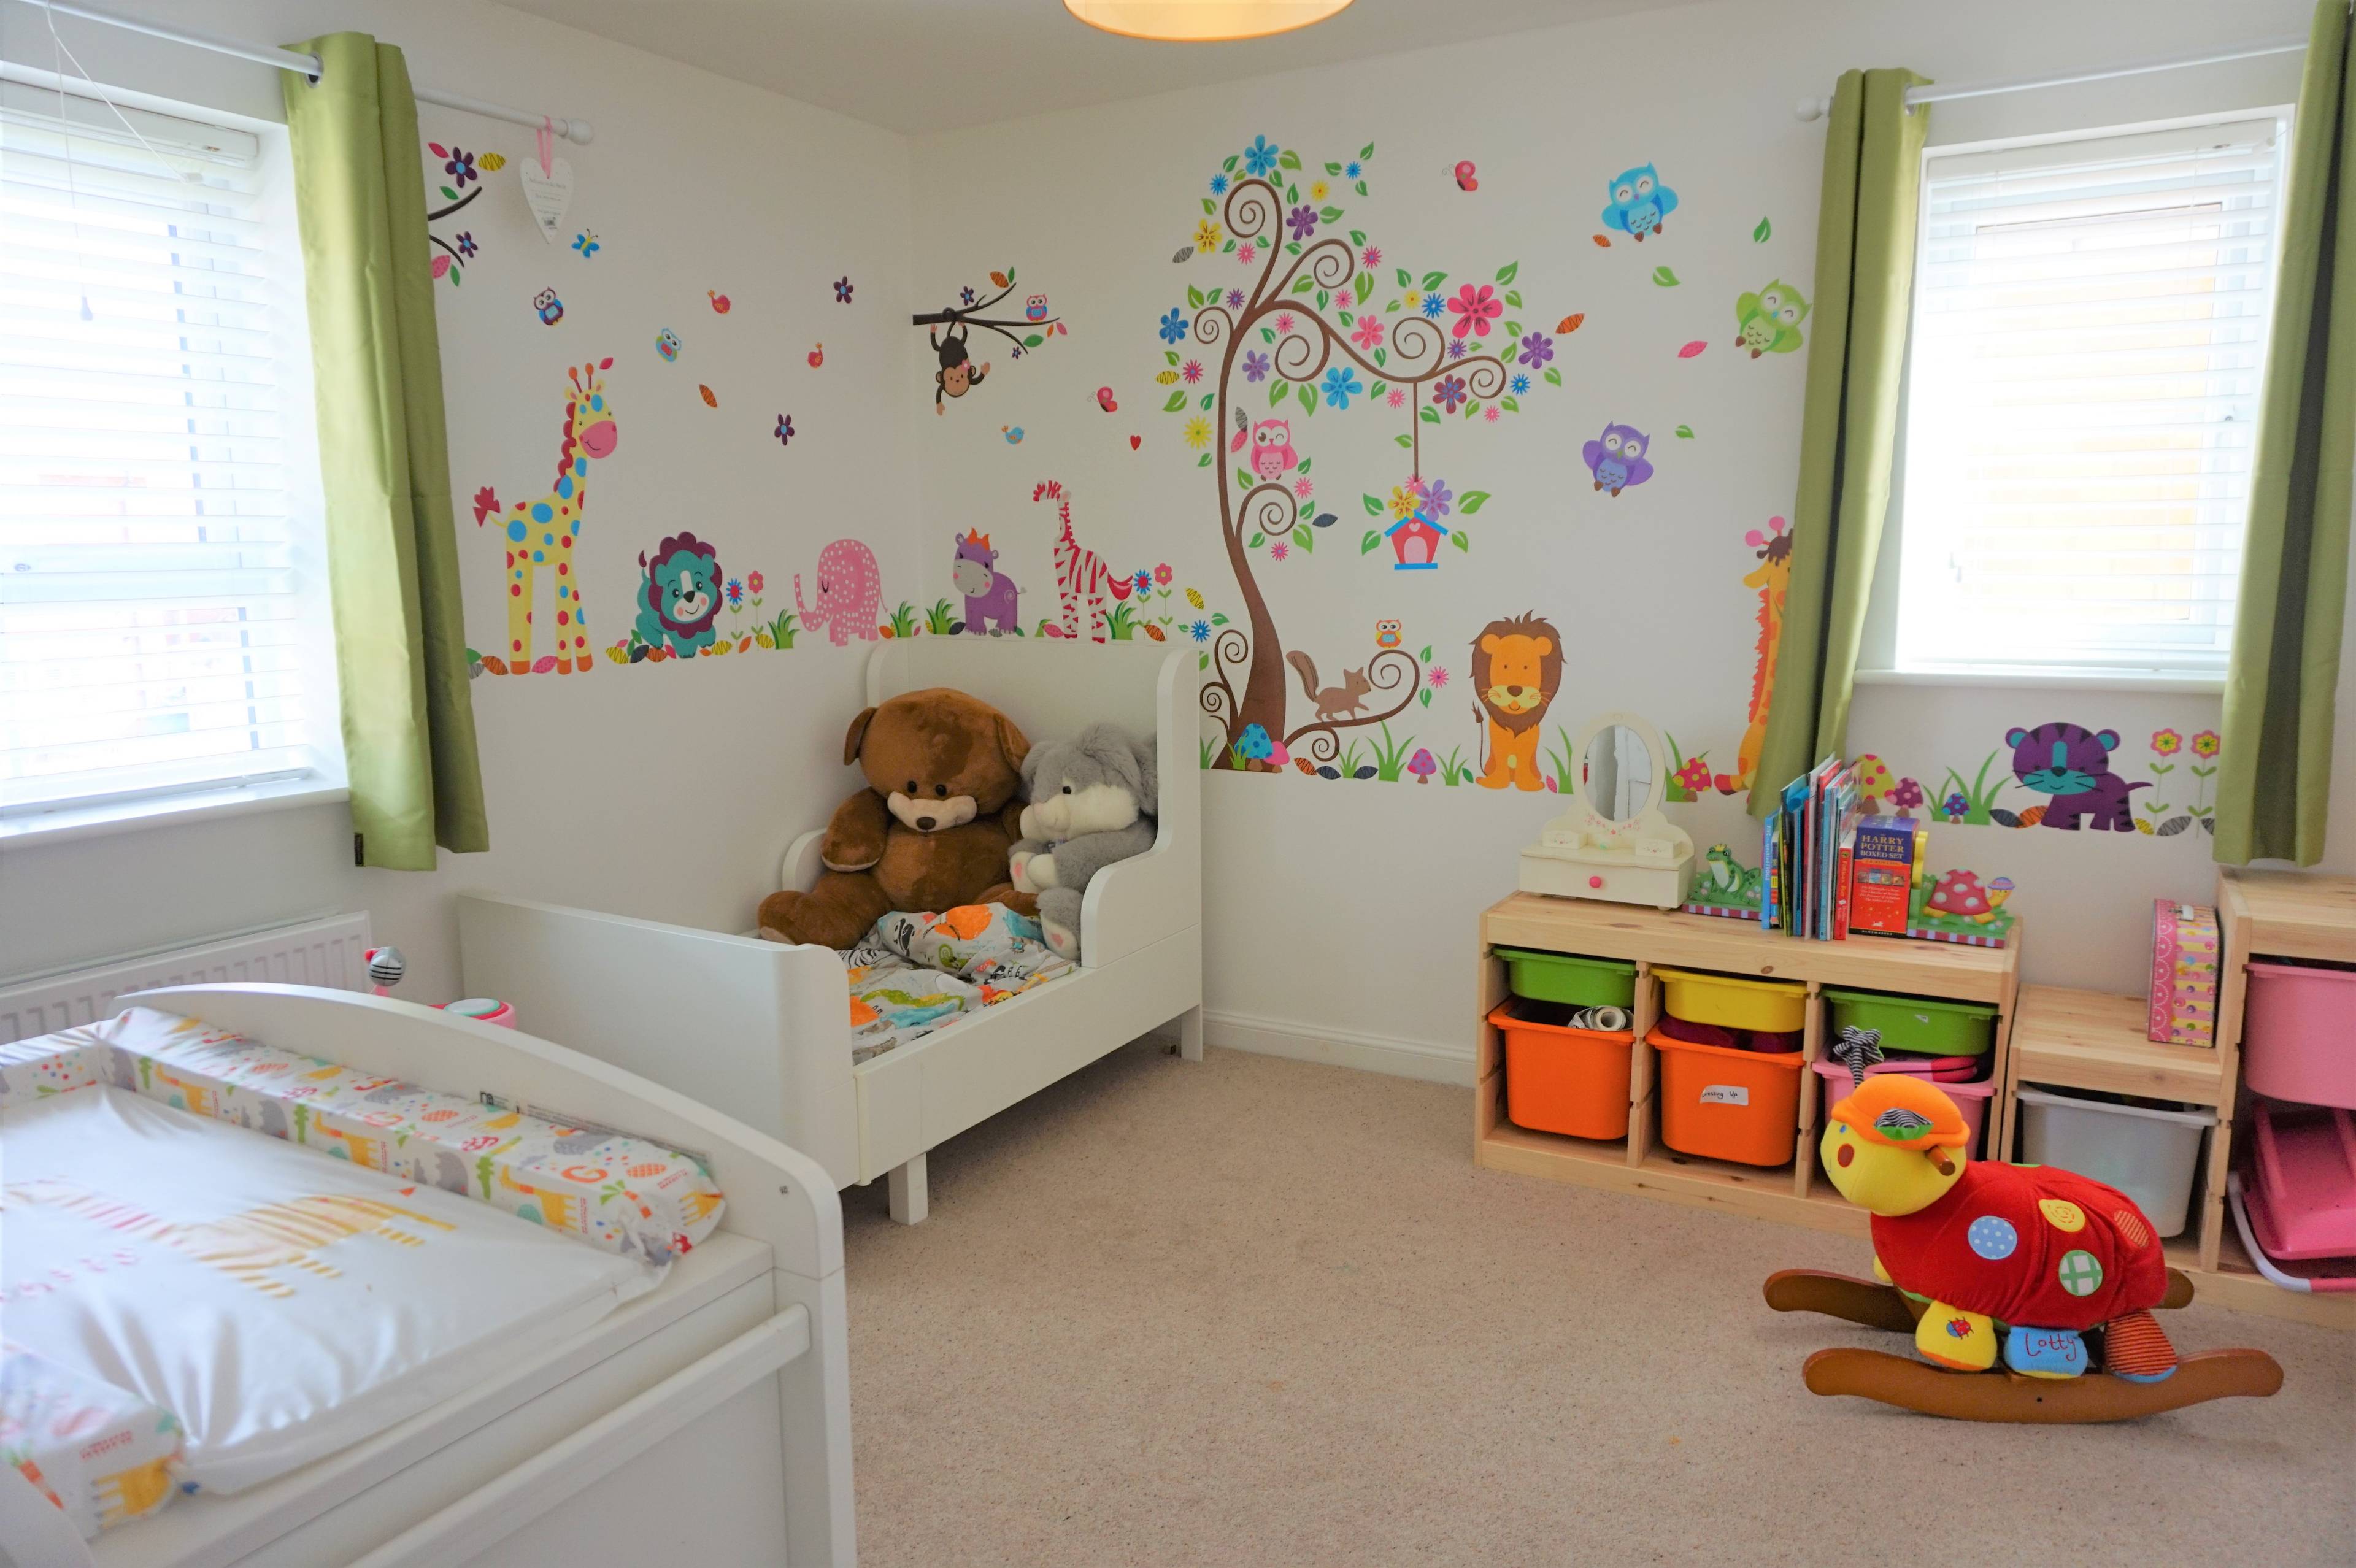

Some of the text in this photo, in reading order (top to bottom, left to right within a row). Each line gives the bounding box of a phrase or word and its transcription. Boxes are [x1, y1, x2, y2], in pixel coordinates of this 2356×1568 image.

[1861, 835, 1904, 845] HARRY
[1860, 842, 1904, 853] POTTER
[2025, 1332, 2077, 1362] Lotty
